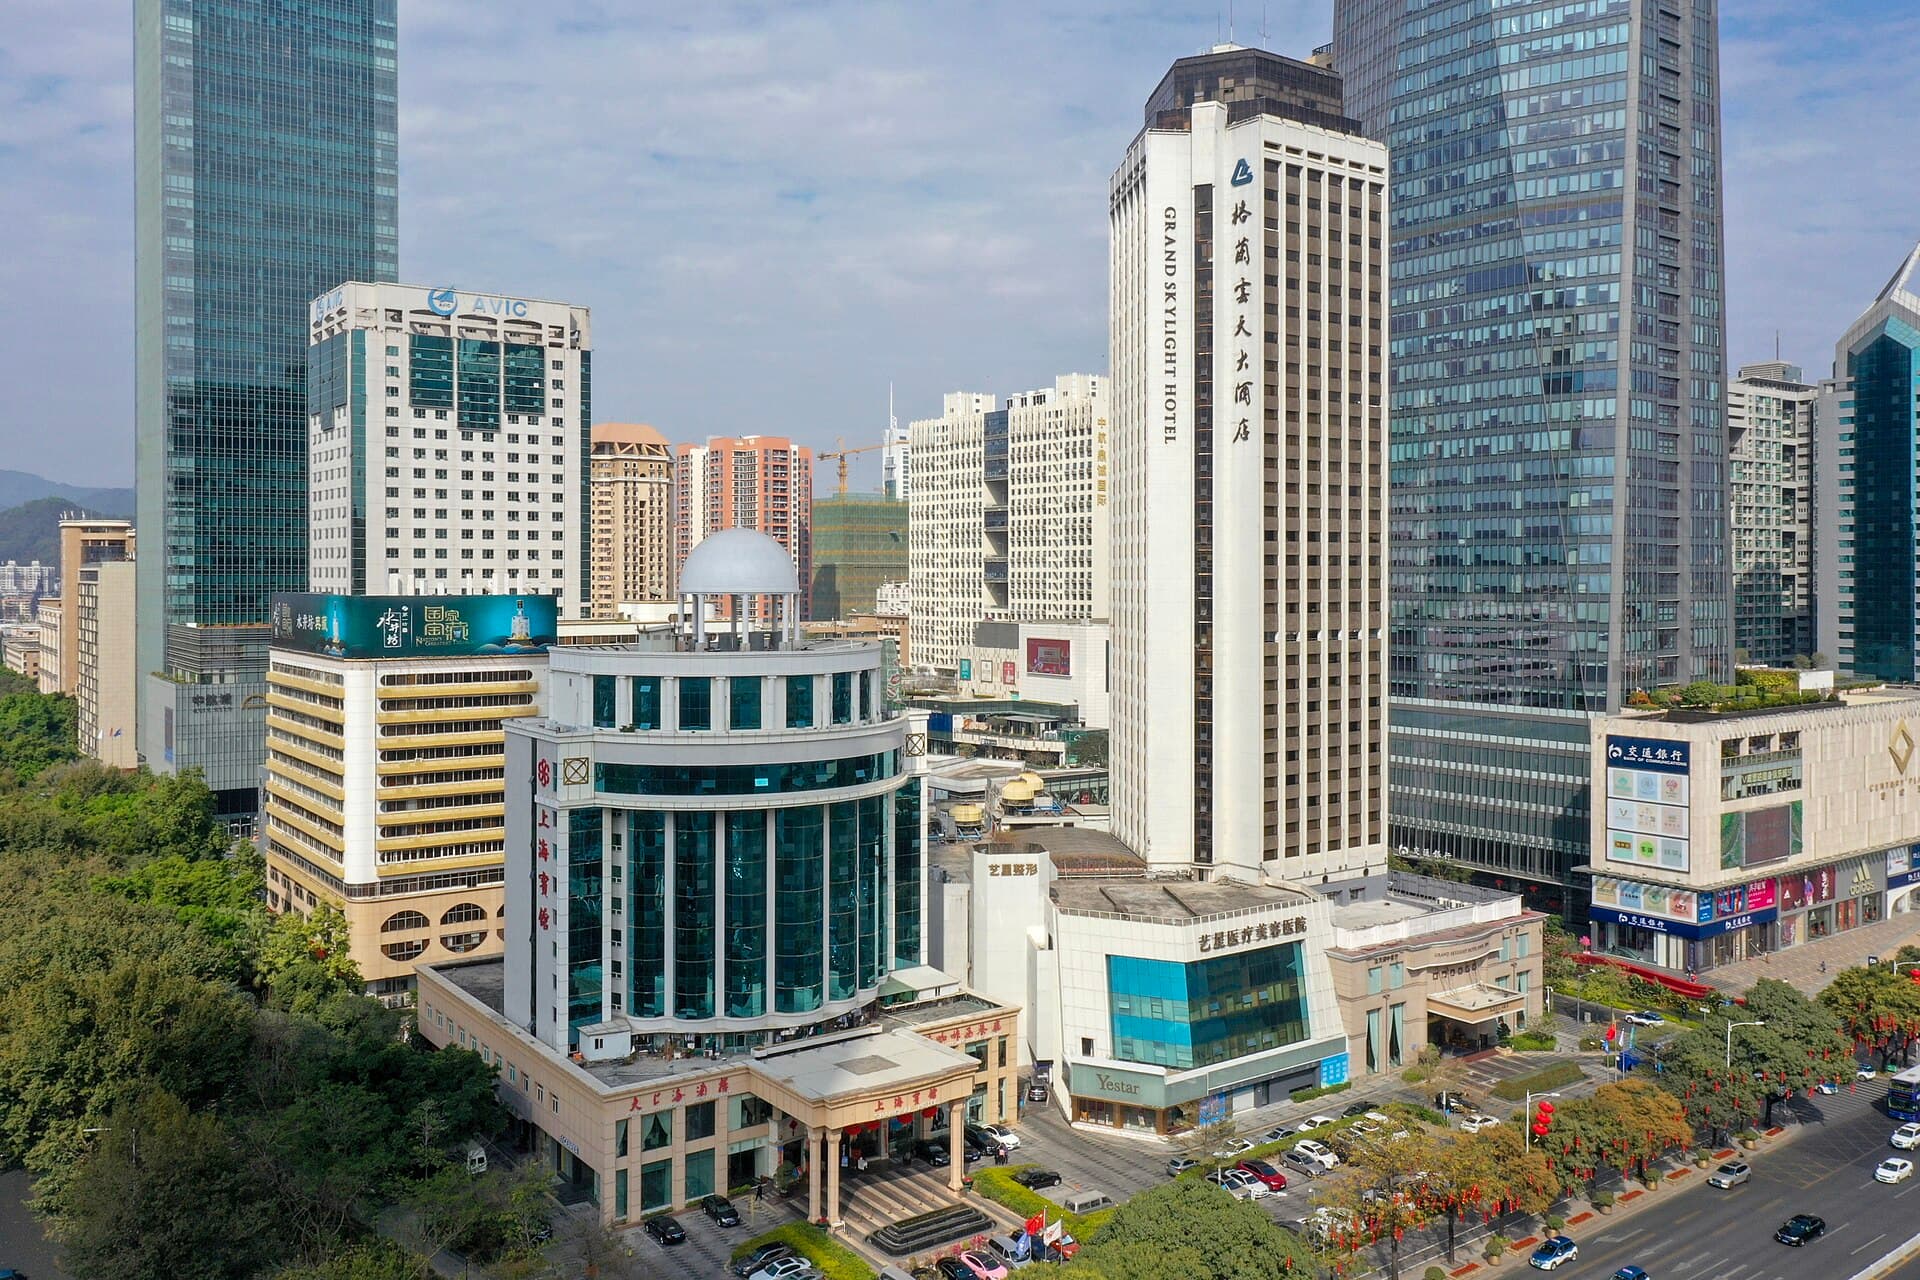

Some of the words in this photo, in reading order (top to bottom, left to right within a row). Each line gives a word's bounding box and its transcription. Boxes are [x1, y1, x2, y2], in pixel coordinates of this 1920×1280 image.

[1164, 206, 1177, 277] GRAND
[473, 297, 528, 318] AVIC
[1164, 281, 1177, 377] SKYLIGHT
[1164, 384, 1177, 444] HOTEL
[1198, 915, 1308, 953] 艺星医疗美容医院
[1095, 1073, 1140, 1096] Yestar
